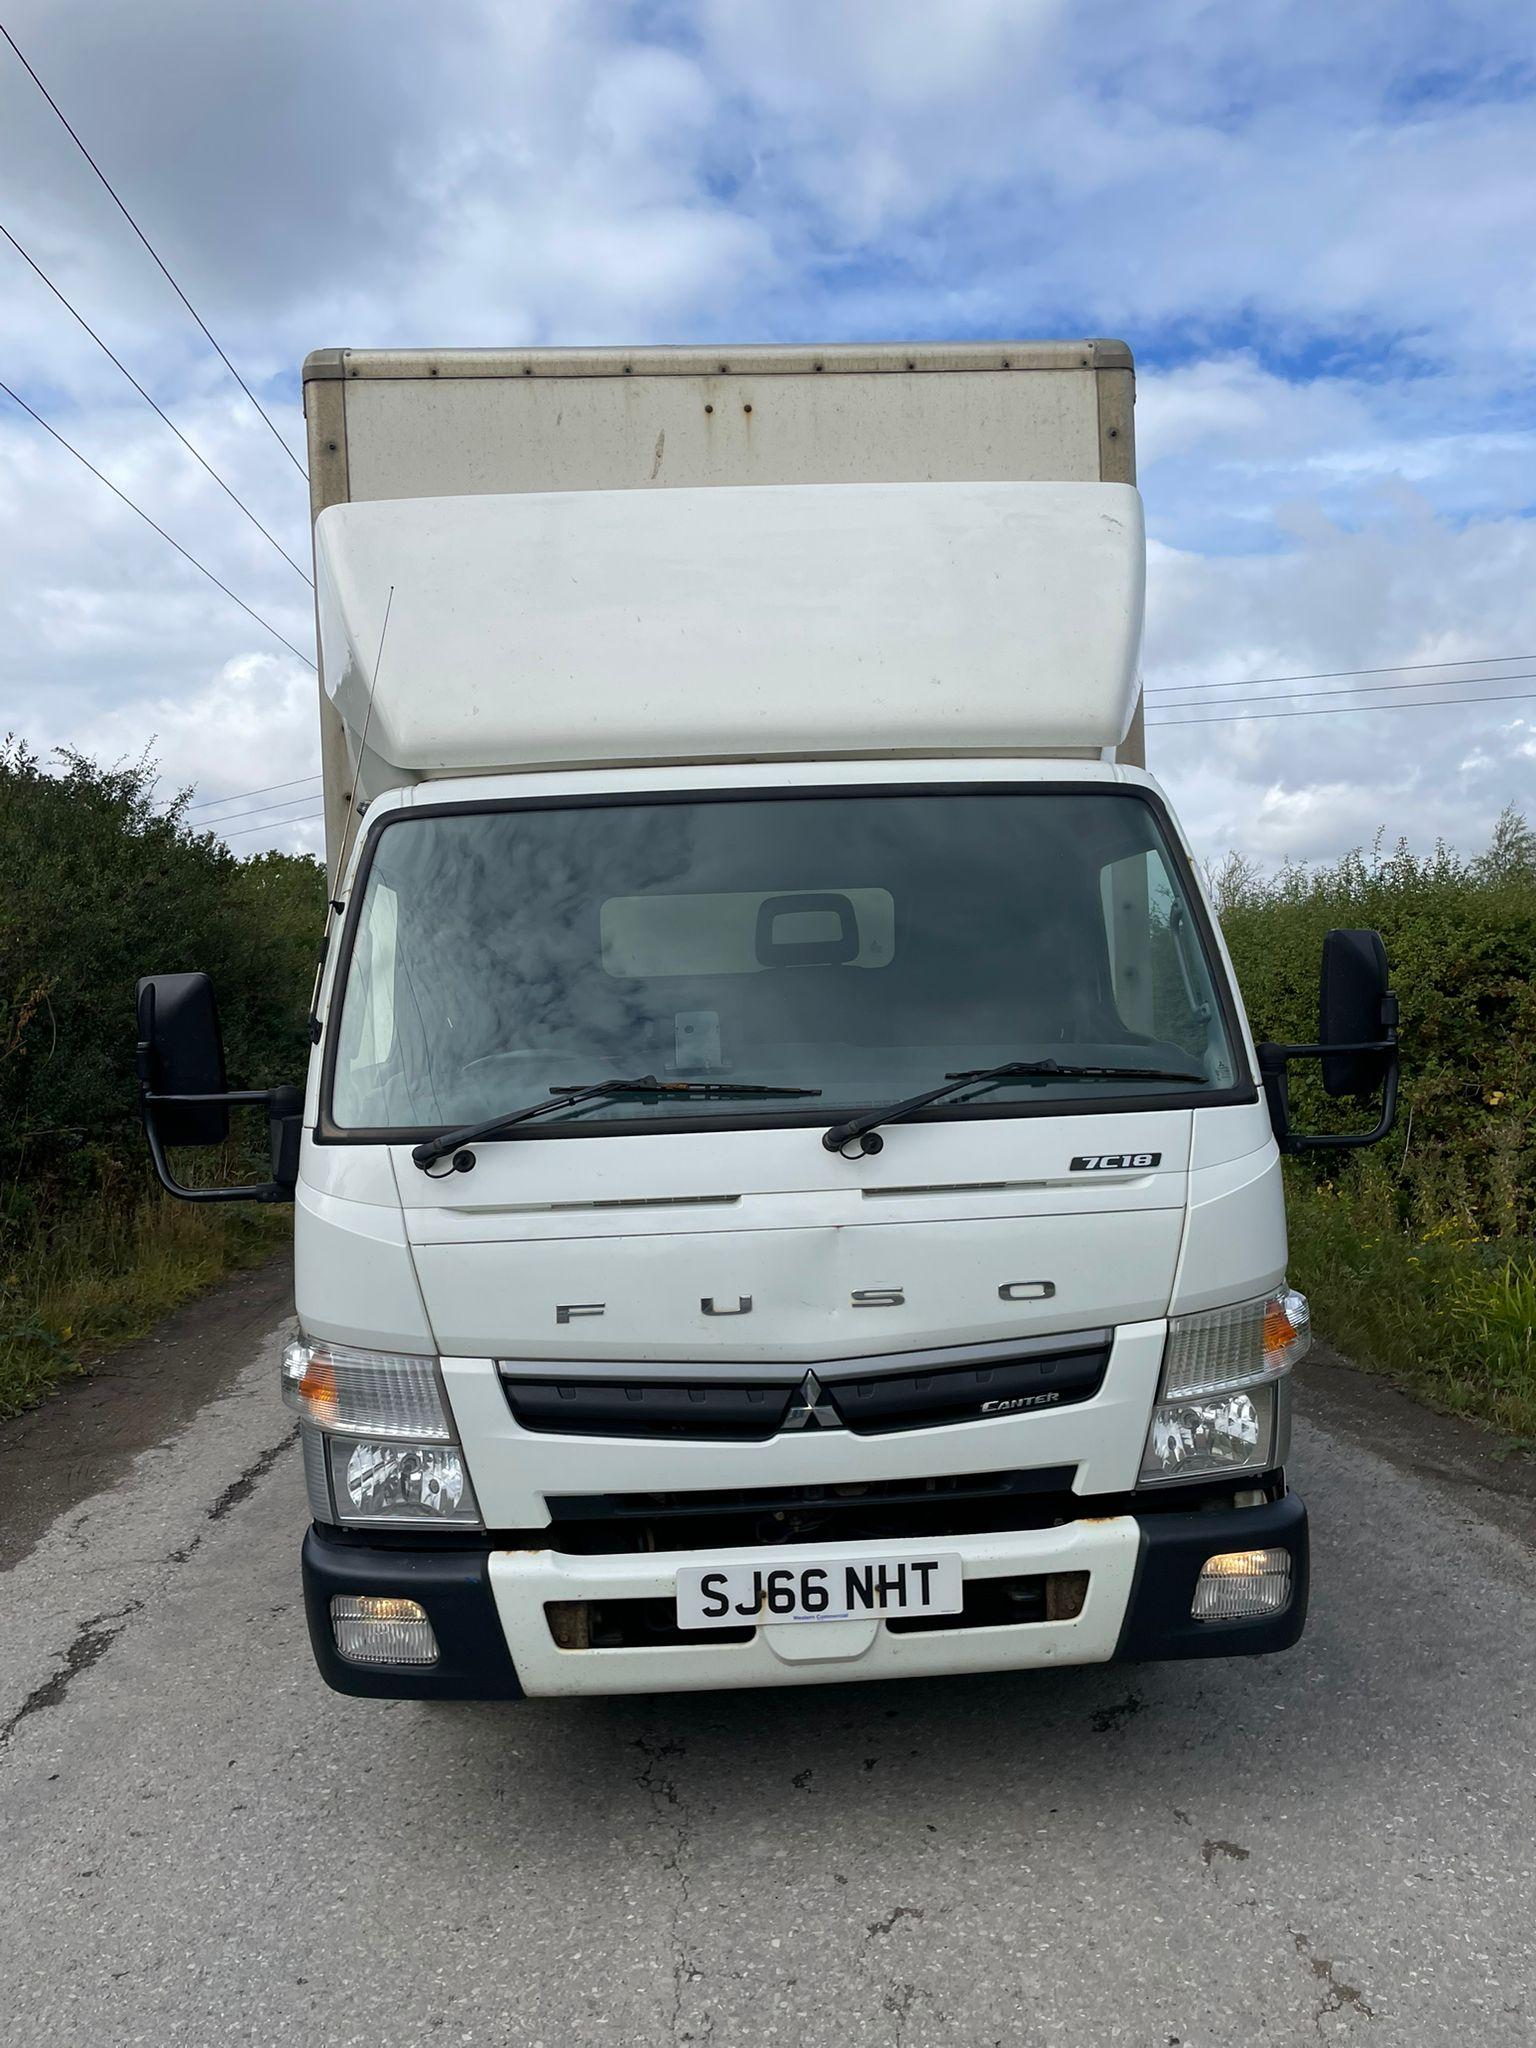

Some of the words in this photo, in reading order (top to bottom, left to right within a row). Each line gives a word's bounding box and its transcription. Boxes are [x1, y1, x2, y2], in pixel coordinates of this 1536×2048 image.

[1082, 1154, 1152, 1169] 7C18
[556, 1281, 1056, 1324] FUSO
[701, 1568, 829, 1618] SJ66
[845, 1561, 938, 1610] NHT
